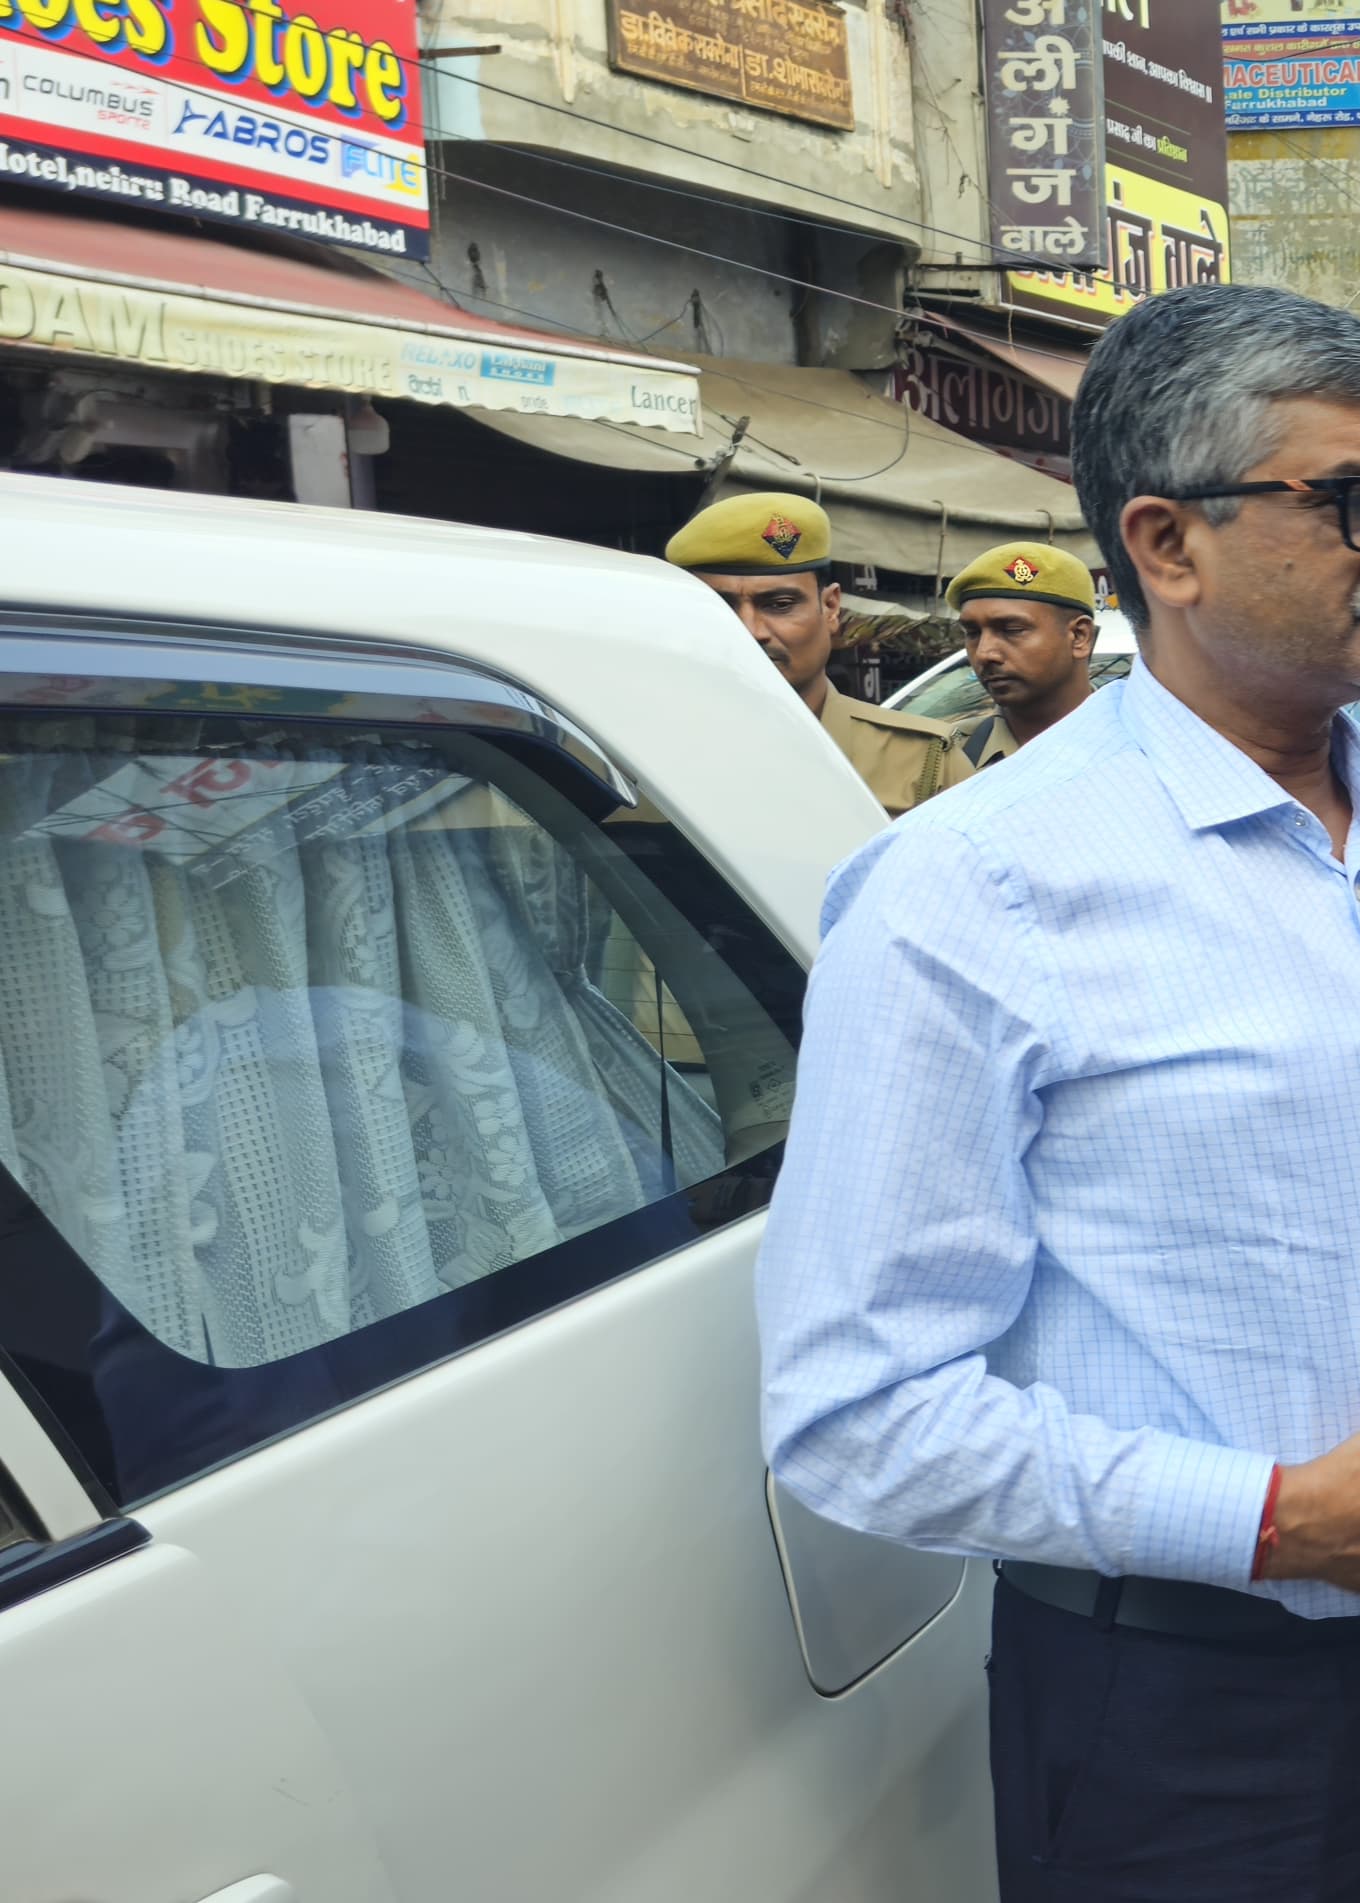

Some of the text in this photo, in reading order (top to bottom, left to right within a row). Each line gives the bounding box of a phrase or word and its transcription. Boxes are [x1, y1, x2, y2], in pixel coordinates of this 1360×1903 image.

[196, 0, 404, 124] Store
[22, 74, 154, 117] COLUMBUS
[1258, 86, 1348, 99] Distributor
[168, 177, 240, 217] Road
[244, 193, 408, 254] Farrukhabad
[1000, 215, 1089, 256] वाले
[629, 384, 698, 416] Lancer
